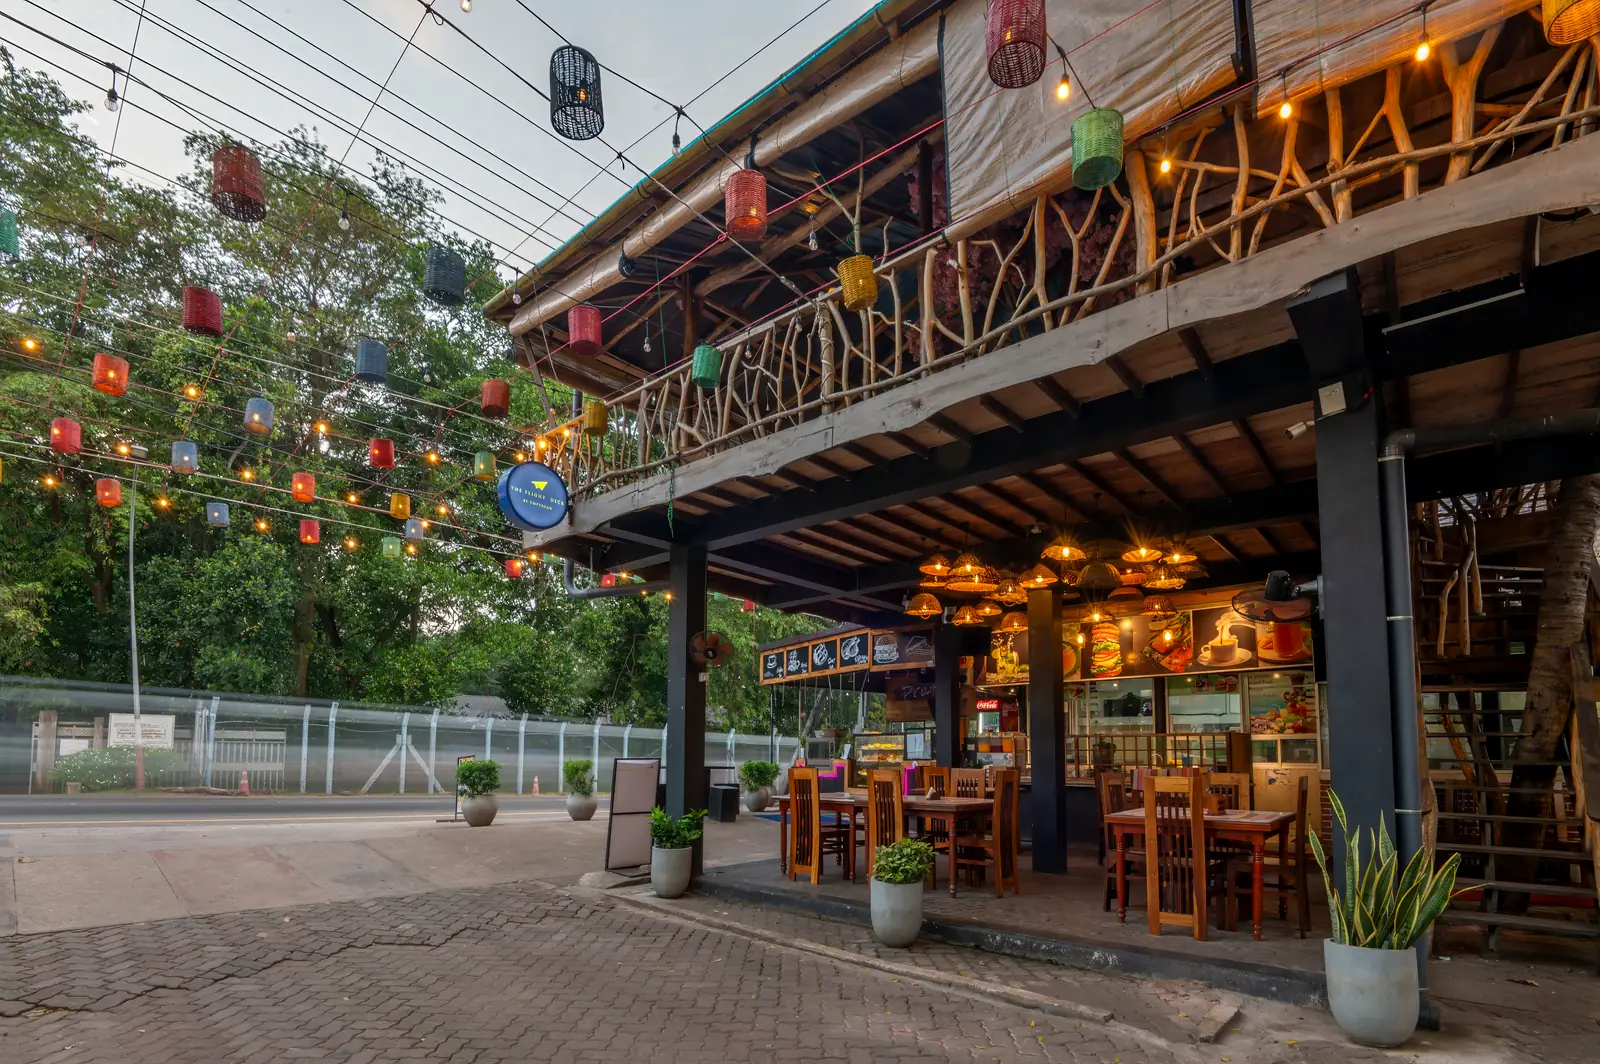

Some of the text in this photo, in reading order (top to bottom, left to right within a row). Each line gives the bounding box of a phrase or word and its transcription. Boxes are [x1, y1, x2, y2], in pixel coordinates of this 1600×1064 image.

[510, 485, 565, 506] THE FLIGHT DECK
